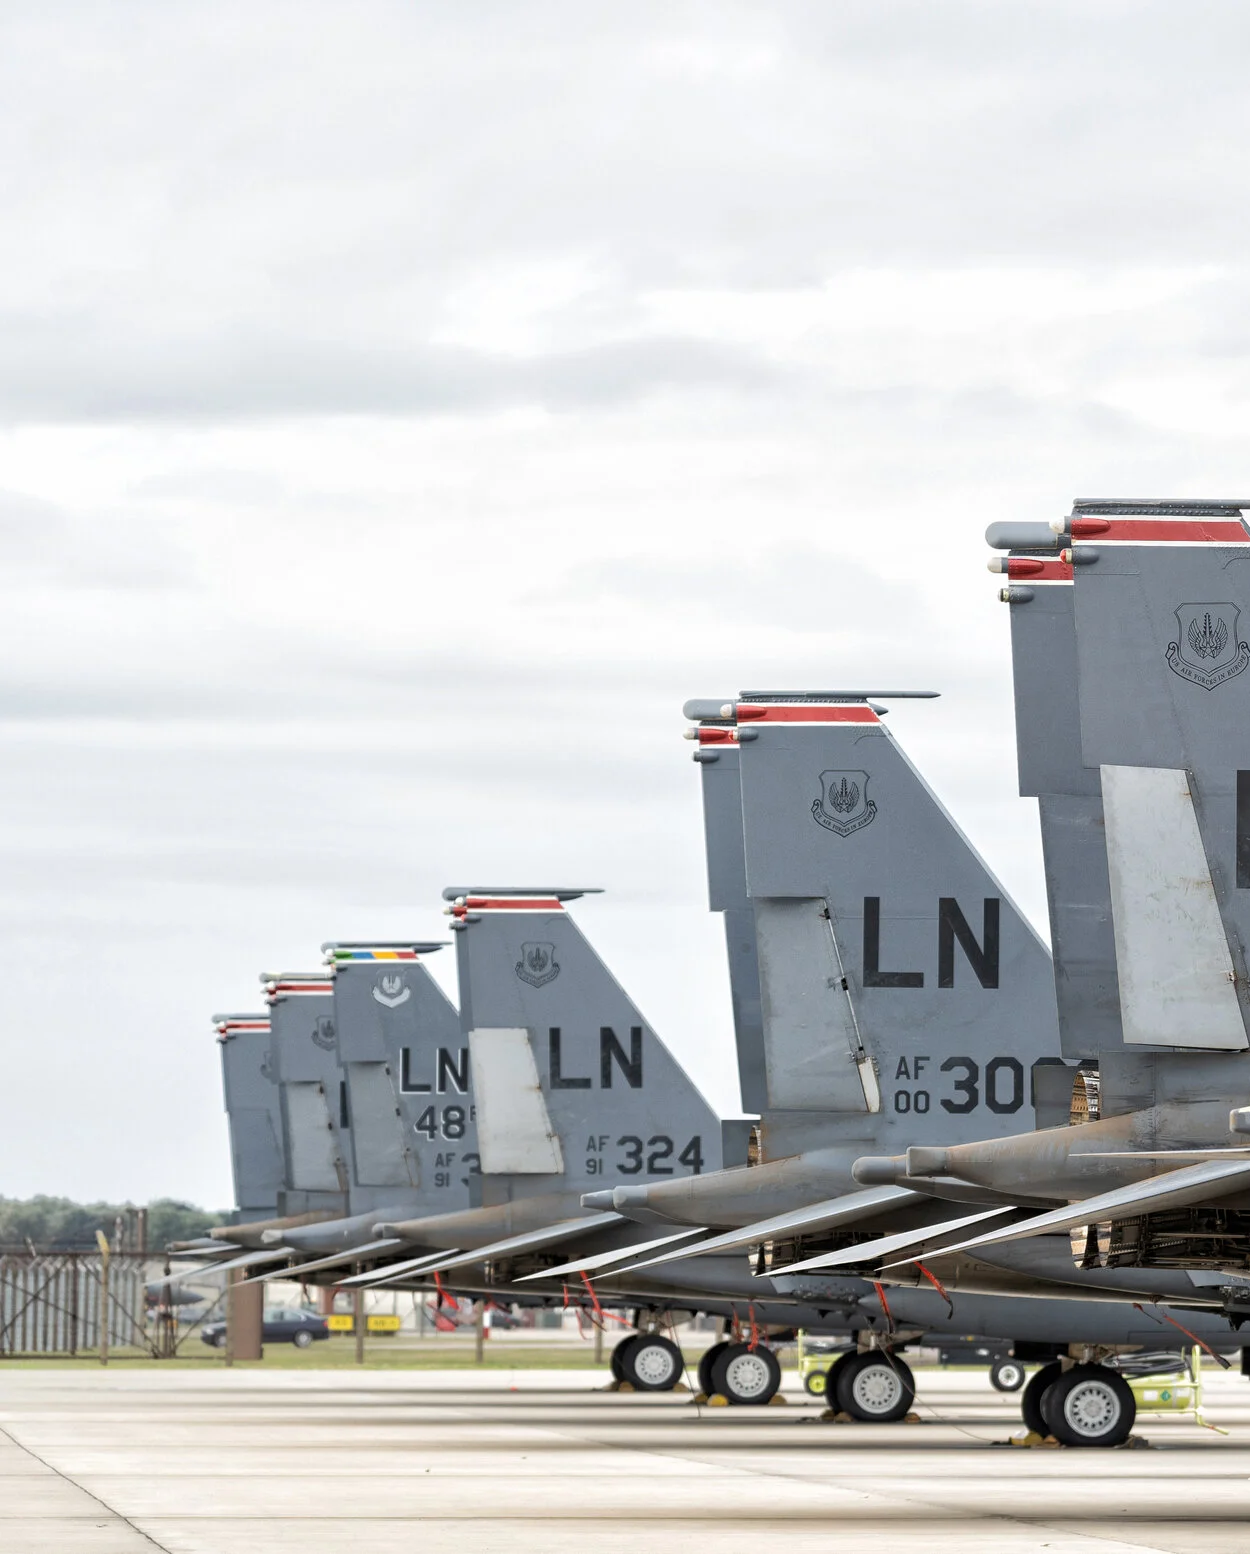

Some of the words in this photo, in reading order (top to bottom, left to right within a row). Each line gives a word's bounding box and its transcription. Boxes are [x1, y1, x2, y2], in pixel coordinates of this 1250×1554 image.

[1180, 667, 1193, 677] AIR
[1194, 673, 1218, 686] FORCES
[1227, 654, 1247, 675] EUROPE
[863, 897, 1000, 989] LN
[400, 1047, 469, 1094] LN
[549, 1027, 643, 1089] LN
[895, 1056, 930, 1081] AF
[895, 1090, 930, 1114] 00
[414, 1105, 465, 1141] 48
[586, 1136, 610, 1152] AF
[617, 1136, 705, 1175] 324
[435, 1153, 456, 1168] AF
[586, 1159, 603, 1176] 91
[435, 1172, 450, 1188] 91
